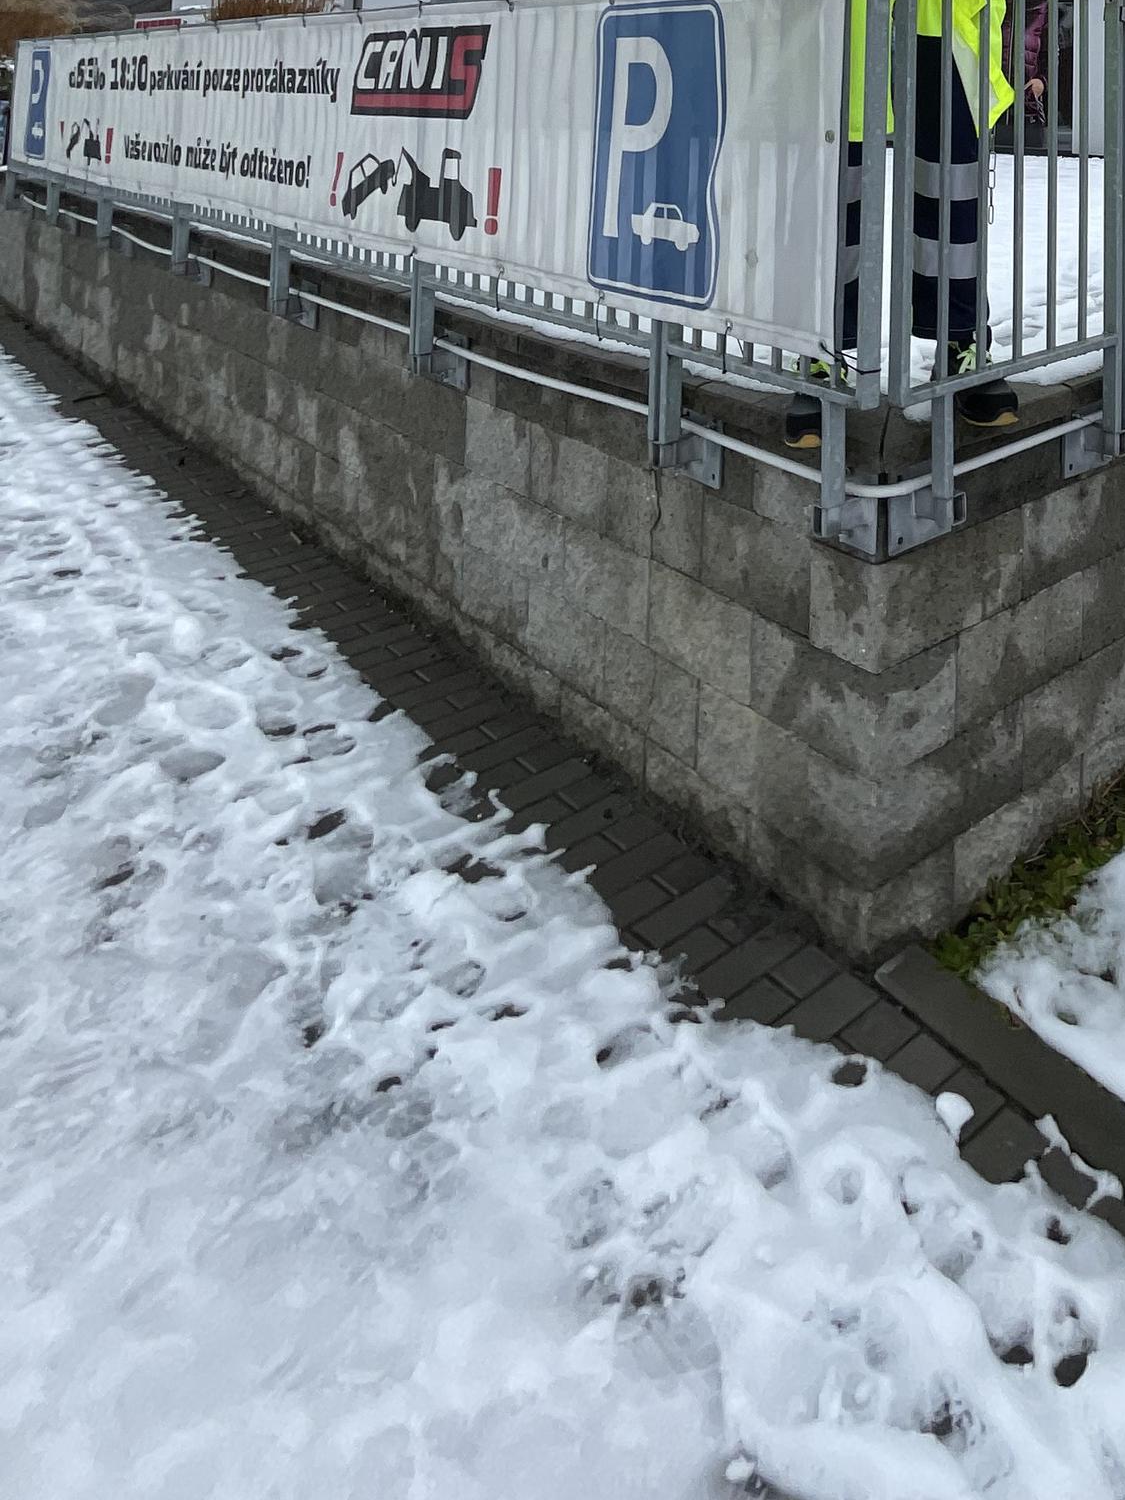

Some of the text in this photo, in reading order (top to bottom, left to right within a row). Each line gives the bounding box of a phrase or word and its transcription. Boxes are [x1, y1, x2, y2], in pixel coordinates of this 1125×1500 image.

[110, 55, 148, 91] 18:30
[355, 34, 483, 104] CANIS
[603, 36, 673, 238] P
